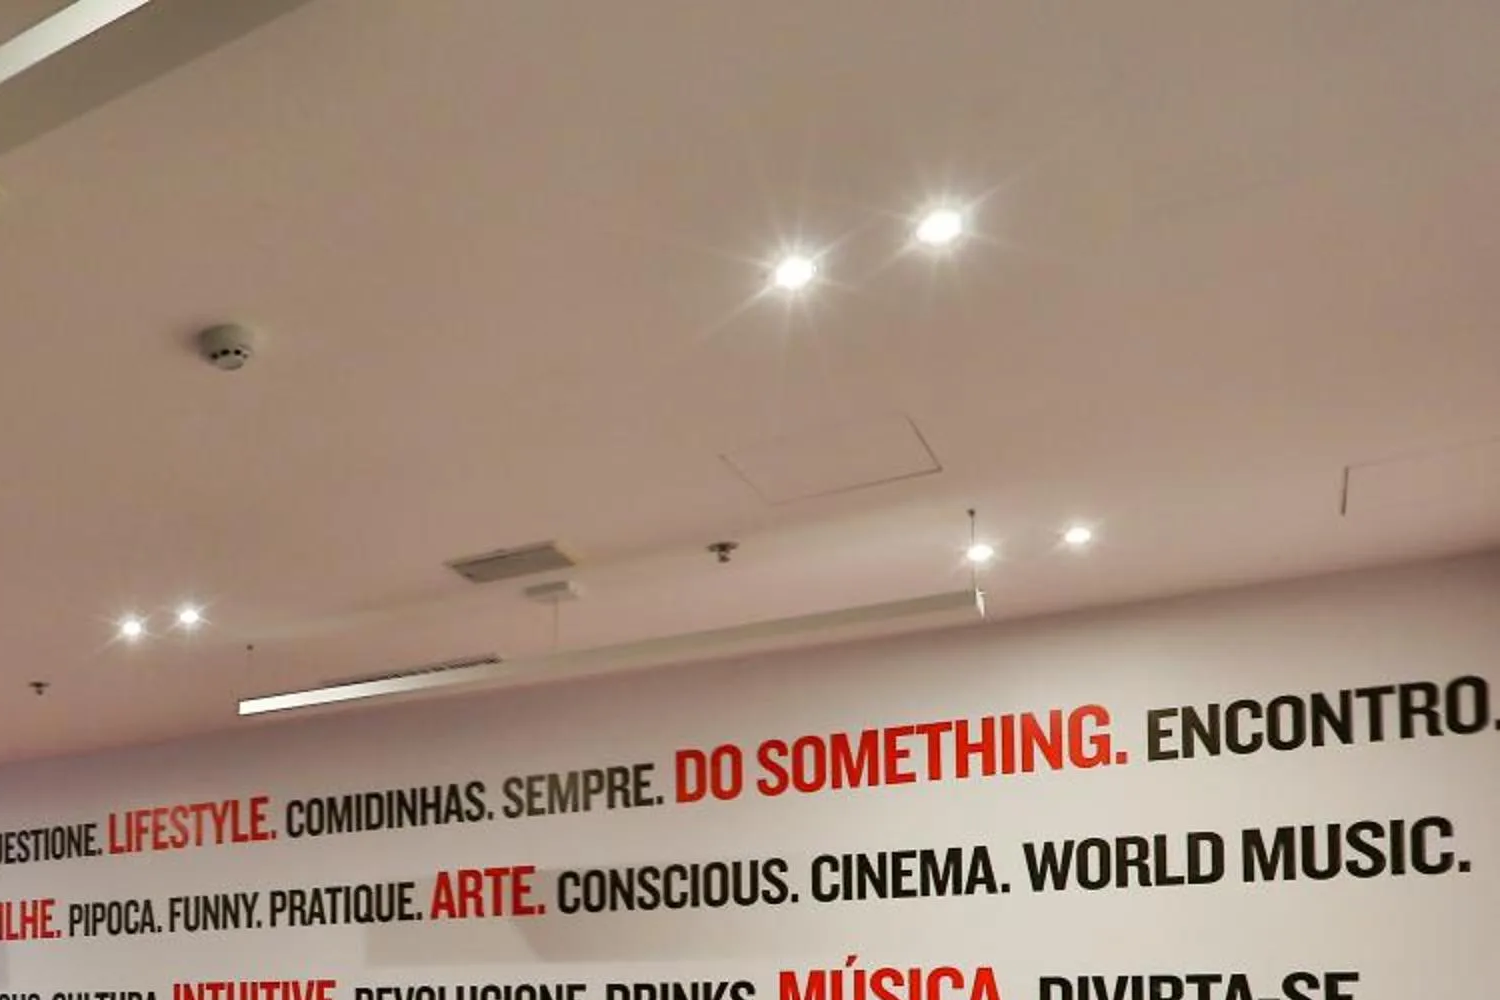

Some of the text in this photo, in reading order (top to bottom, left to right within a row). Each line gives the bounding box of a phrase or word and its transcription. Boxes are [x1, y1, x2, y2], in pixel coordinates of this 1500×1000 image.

[109, 796, 276, 854] LIFESTYLE.
[287, 781, 493, 838] COMIDINHAS.
[503, 763, 663, 818] SEMPRE.
[676, 744, 742, 802] DO
[757, 705, 1126, 796] SOMETHING.
[70, 900, 162, 936] PIPOCA.
[169, 892, 261, 932] FUNNY.
[270, 882, 422, 927] PRATIQUE.
[431, 866, 545, 918] ARTE.
[558, 858, 798, 914] CONSCIOUS.
[812, 846, 1010, 902] CINEMA.
[1023, 832, 1224, 892] WORLD
[1242, 816, 1470, 882] MUSIC.
